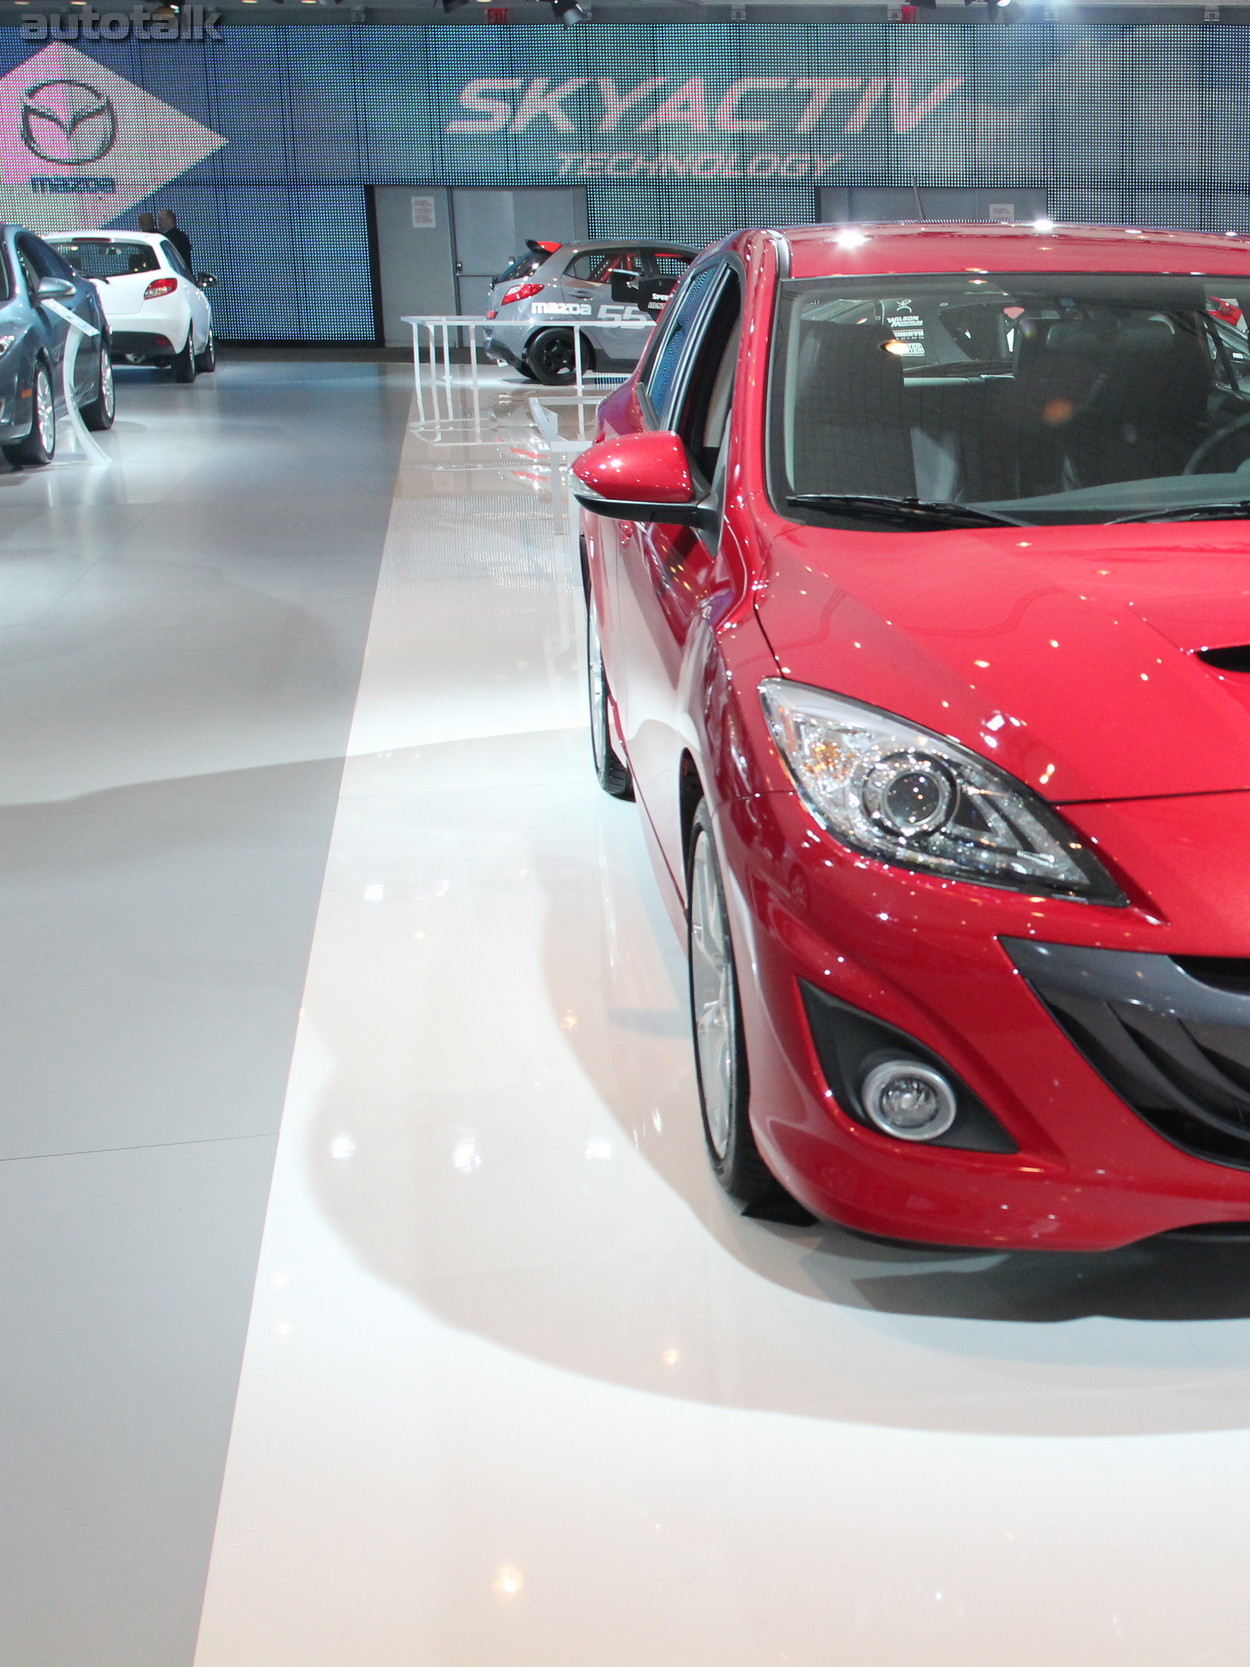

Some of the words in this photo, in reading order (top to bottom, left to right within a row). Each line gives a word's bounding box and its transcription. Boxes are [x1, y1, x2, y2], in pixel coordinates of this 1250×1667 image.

[445, 76, 966, 134] SKYACTIV
[556, 152, 842, 177] TECHNOLOGY
[531, 302, 592, 316] mazda
[597, 304, 649, 330] 55
